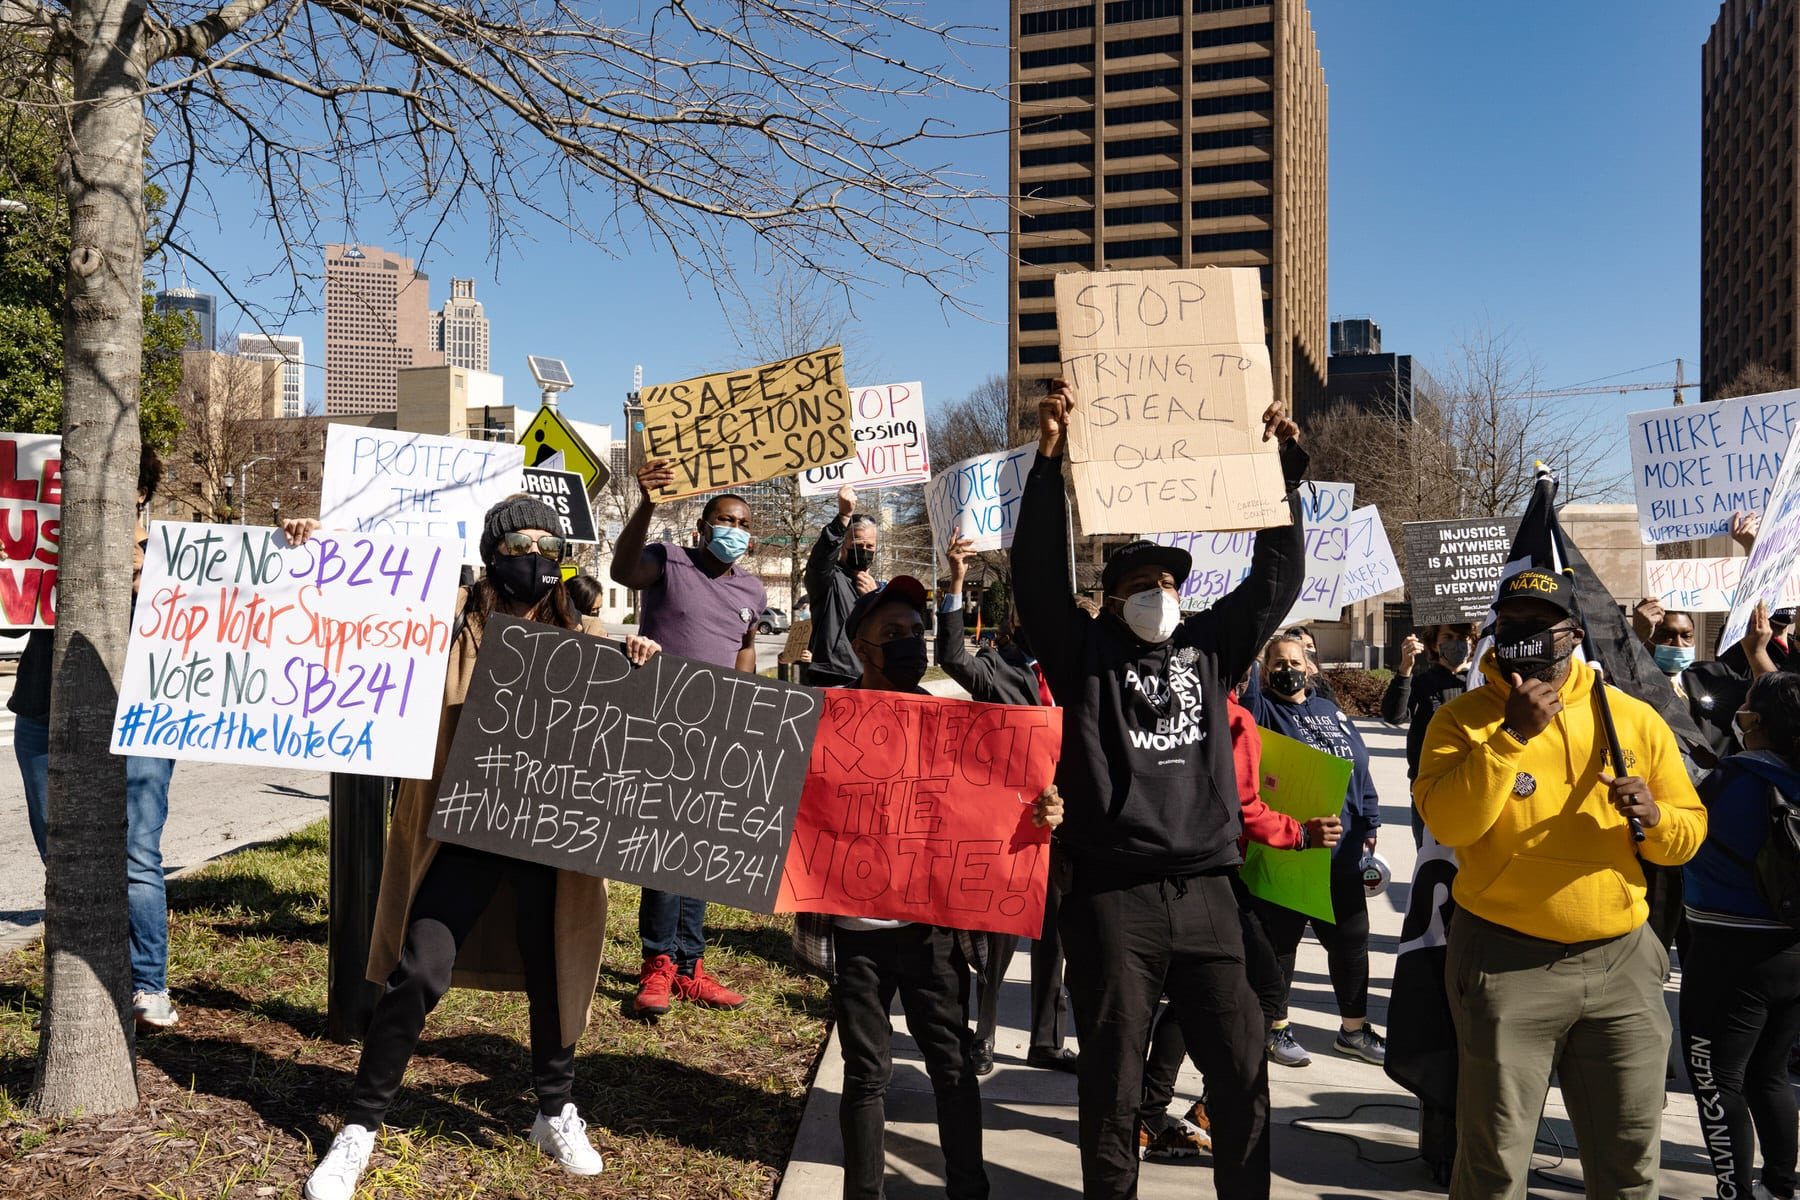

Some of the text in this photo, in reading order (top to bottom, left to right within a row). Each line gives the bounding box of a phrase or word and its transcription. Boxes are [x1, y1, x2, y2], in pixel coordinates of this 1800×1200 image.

[166, 290, 196, 298] WESTIN
[1073, 281, 1206, 338] STOP
[1062, 353, 1193, 389] TRYING
[859, 385, 910, 421] OP
[1090, 393, 1234, 427] STEAL
[650, 389, 846, 457] ELECTIONS
[1639, 411, 1727, 454] THERE
[0, 440, 61, 505] LE
[353, 437, 495, 486] PROTECT
[806, 432, 929, 484] Our VOTE!
[1644, 455, 1713, 488] MORE
[391, 488, 441, 512] THE
[521, 474, 571, 494] ORGIA
[1096, 470, 1217, 510] VOTES!
[971, 496, 1020, 535] VOT
[1651, 495, 1704, 521] BILLS
[1439, 539, 1510, 555] ANYWHERE
[1440, 526, 1506, 541] INJUSTICE
[1647, 518, 1730, 543] SUPPRESSING
[162, 526, 441, 602] Vote No SB241
[1428, 552, 1503, 568] IS A THREAT
[1434, 580, 1499, 596] EVERYWH
[1509, 578, 1558, 593] NAACP
[1660, 589, 1703, 608] THE
[139, 585, 449, 676] Stop Voter Suppression
[150, 648, 415, 718] Vote No SB241
[489, 625, 815, 752] STOP VOTER
[478, 688, 785, 804] SUPPRESSION
[837, 779, 949, 836] THE
[784, 830, 1041, 917] VOTE!
[1691, 1035, 1718, 1090] KLEIN
[1706, 1125, 1738, 1200] CALVIN
